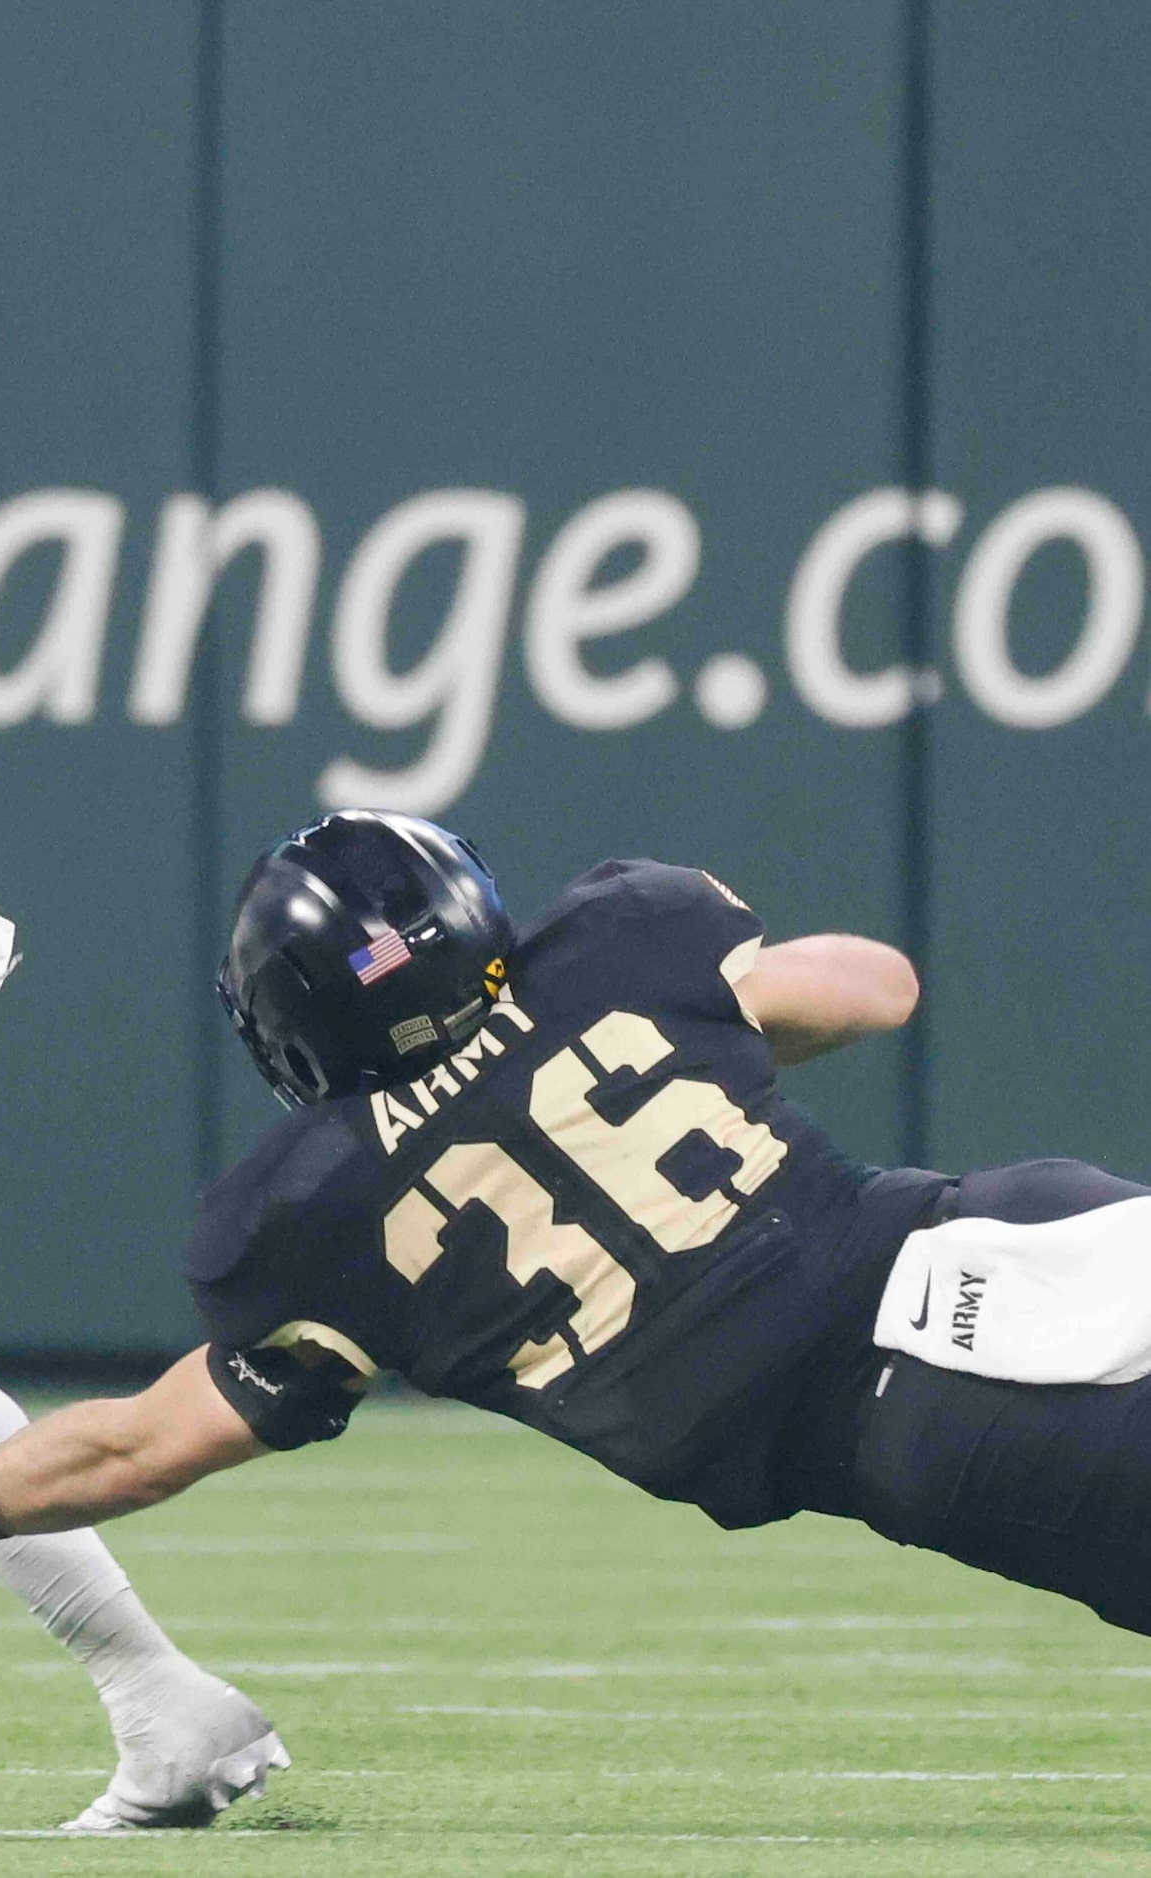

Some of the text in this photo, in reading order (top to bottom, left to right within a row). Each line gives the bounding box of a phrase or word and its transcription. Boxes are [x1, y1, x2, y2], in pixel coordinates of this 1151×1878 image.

[369, 981, 536, 1157] ARMY
[383, 1009, 790, 1390] 36
[951, 1265, 988, 1352] ARMY
